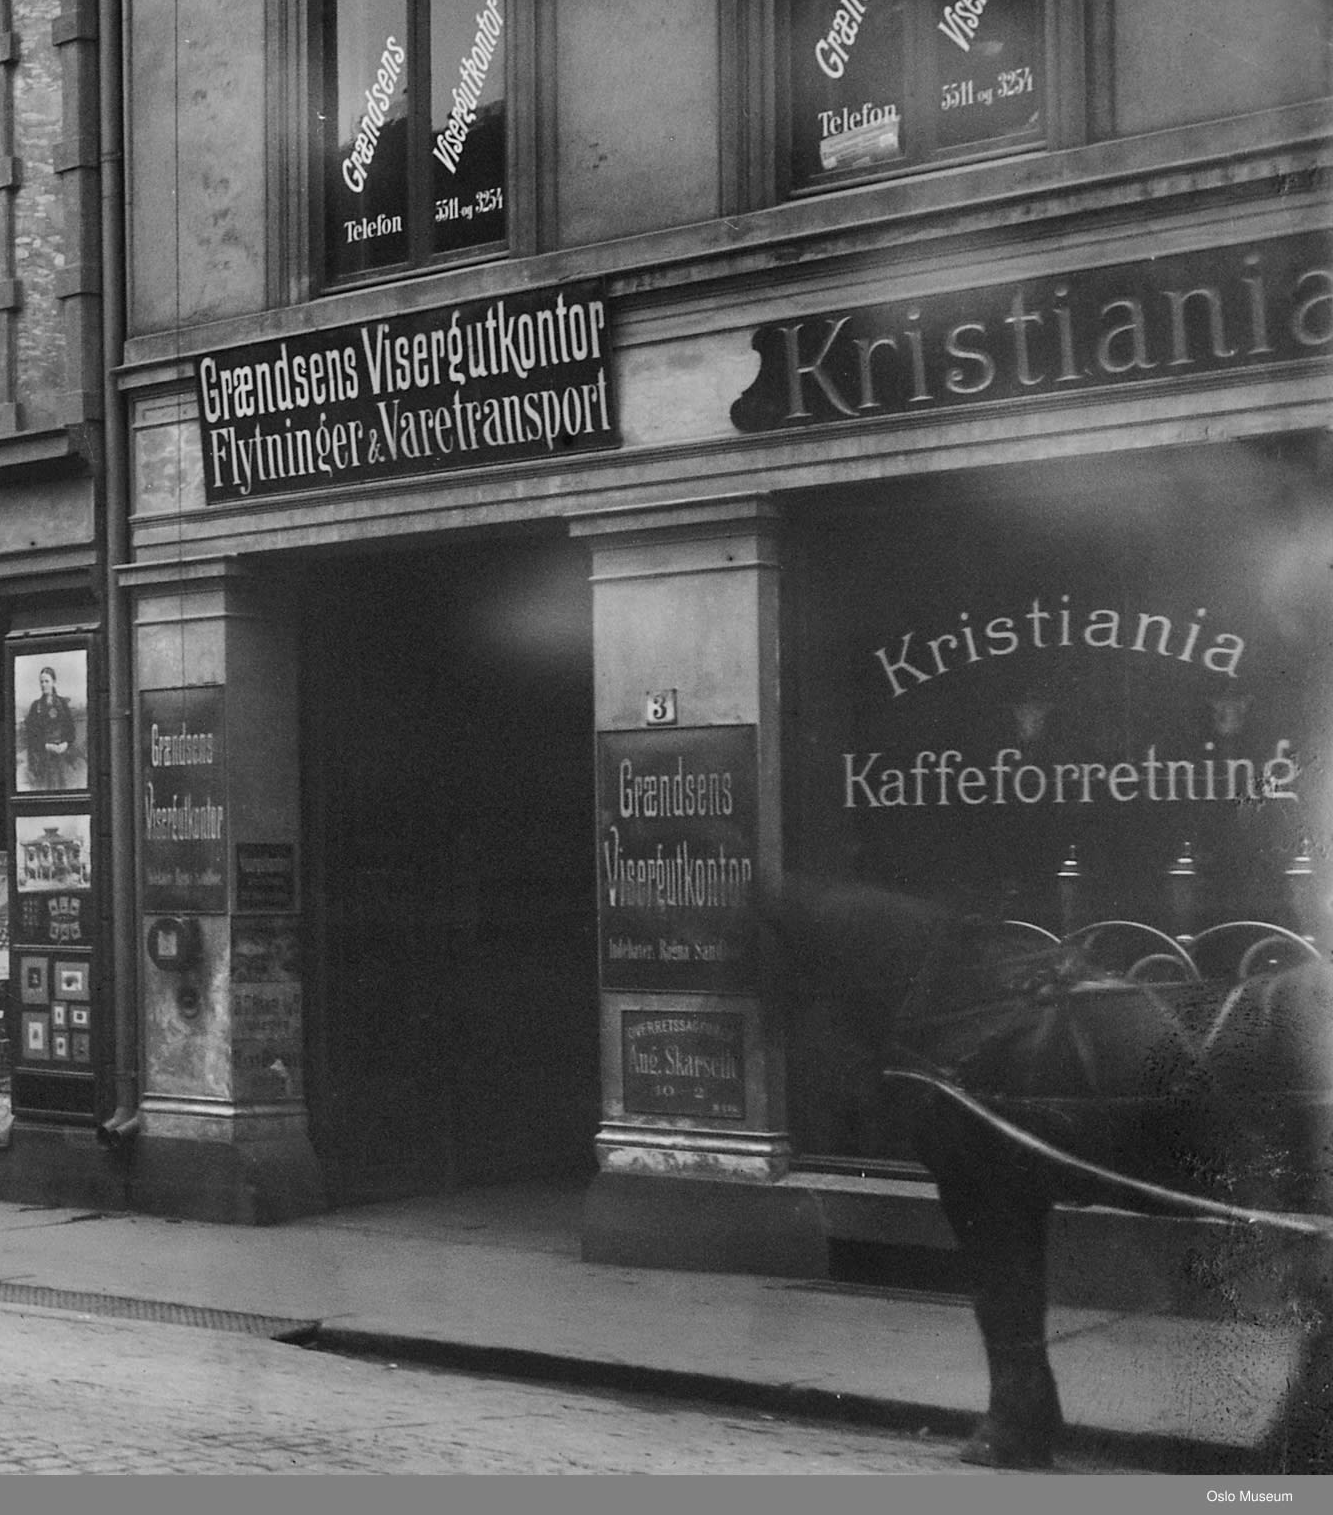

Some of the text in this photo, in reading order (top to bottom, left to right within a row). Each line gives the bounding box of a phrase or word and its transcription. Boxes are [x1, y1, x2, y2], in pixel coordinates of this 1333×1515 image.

[342, 36, 405, 193] Grændsens
[818, 67, 1033, 137] Telefon 5511 og 3254
[344, 187, 503, 243] Telefon 5511 og 3254
[200, 292, 605, 423] Grændsens Visergutkontor
[778, 253, 1333, 419] Kristiania
[209, 367, 612, 495] Flytninger & Varetransport
[874, 593, 1247, 698] Kristiania
[151, 722, 213, 767] Grændsens
[653, 694, 669, 720] 3
[620, 757, 733, 818] Grændsens
[842, 739, 1301, 810] Kaffeforretning
[604, 825, 752, 909] Visergutkontor
